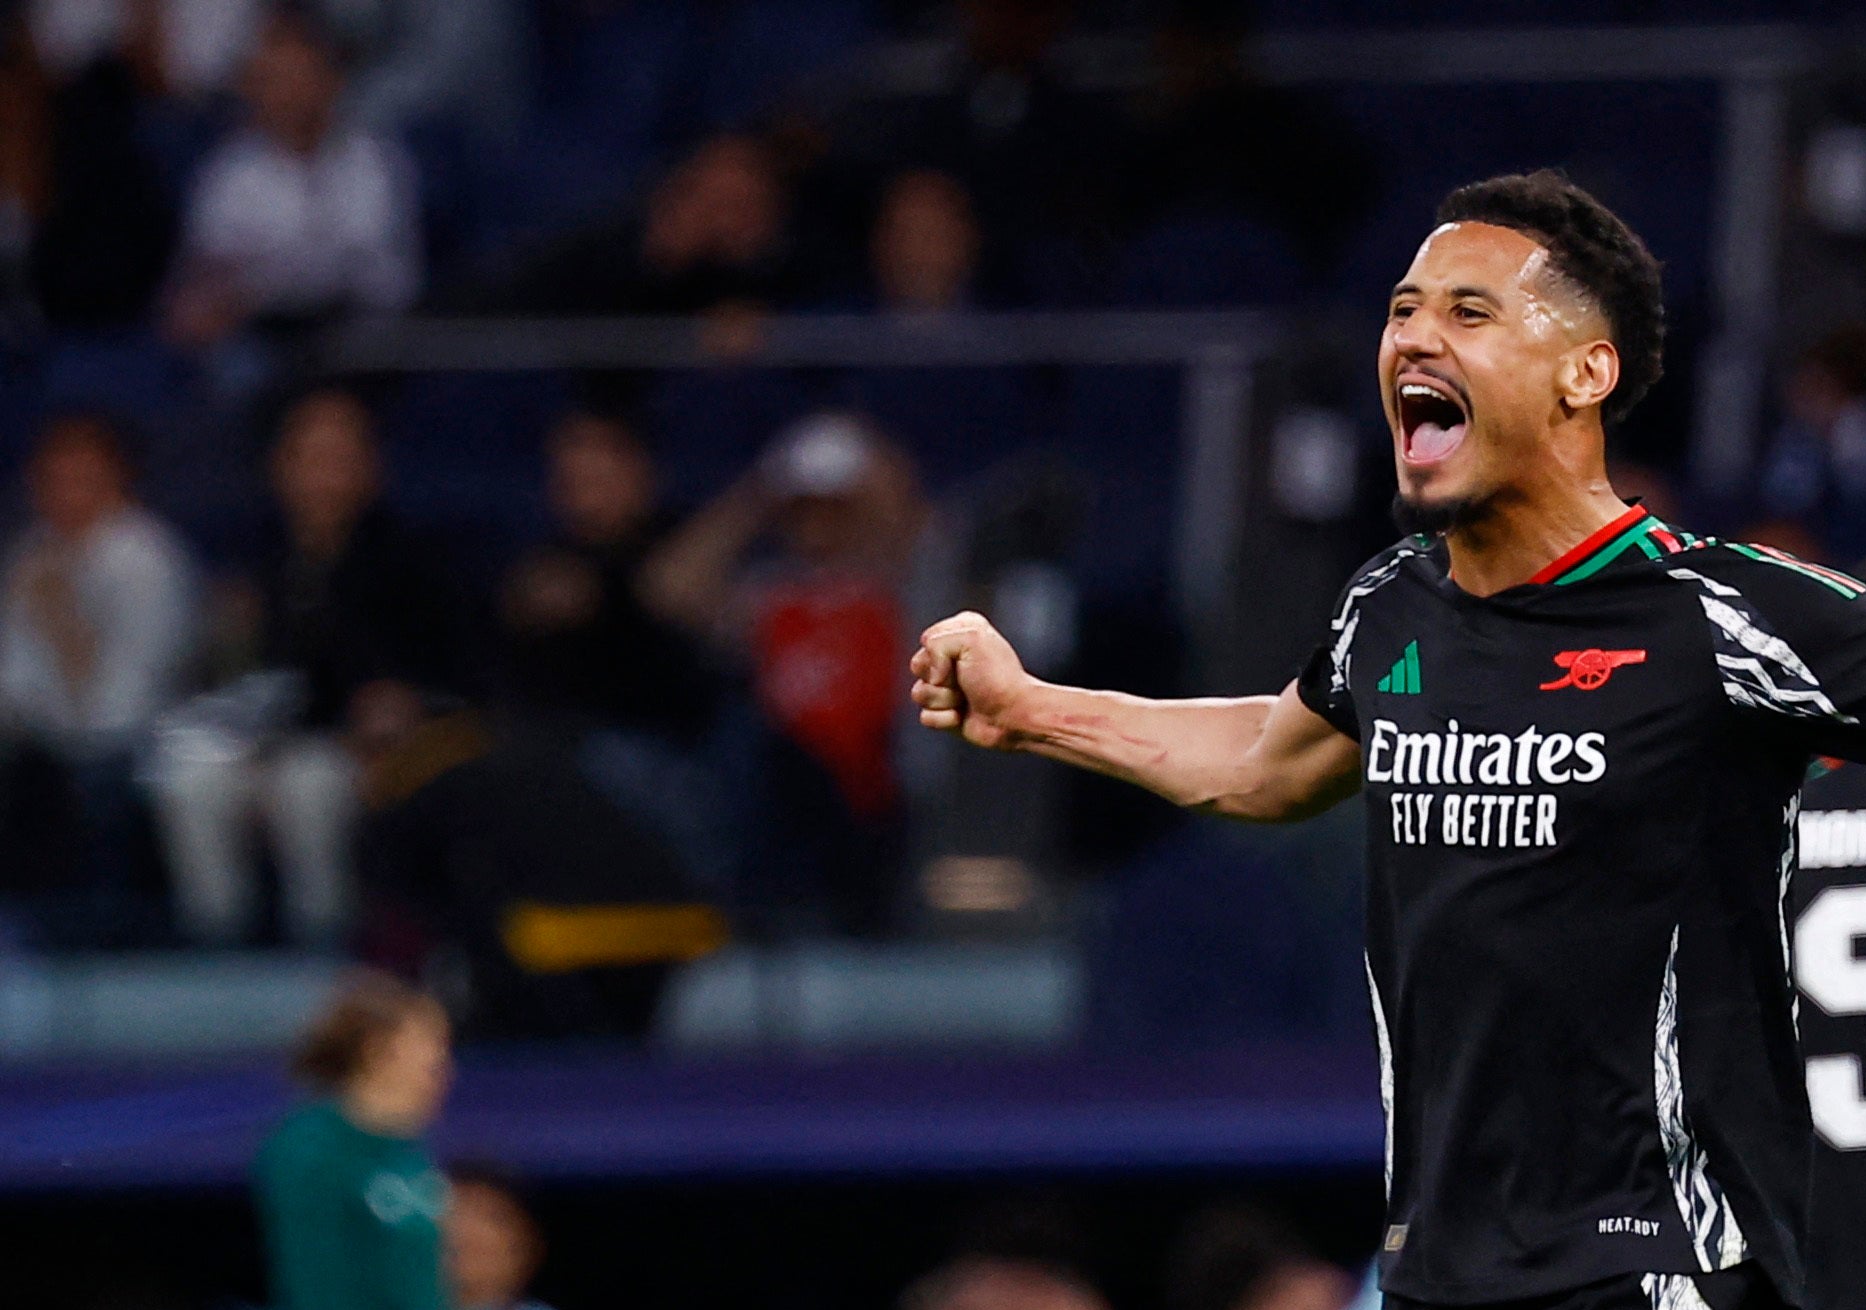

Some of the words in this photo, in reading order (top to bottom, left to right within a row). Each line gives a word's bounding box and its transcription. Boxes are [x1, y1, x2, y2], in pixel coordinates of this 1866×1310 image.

[1367, 718, 1607, 786] Emirates
[1391, 793, 1434, 845] FLY
[1442, 794, 1557, 847] BETTER
[1598, 1216, 1660, 1236] HEAT.RDY
